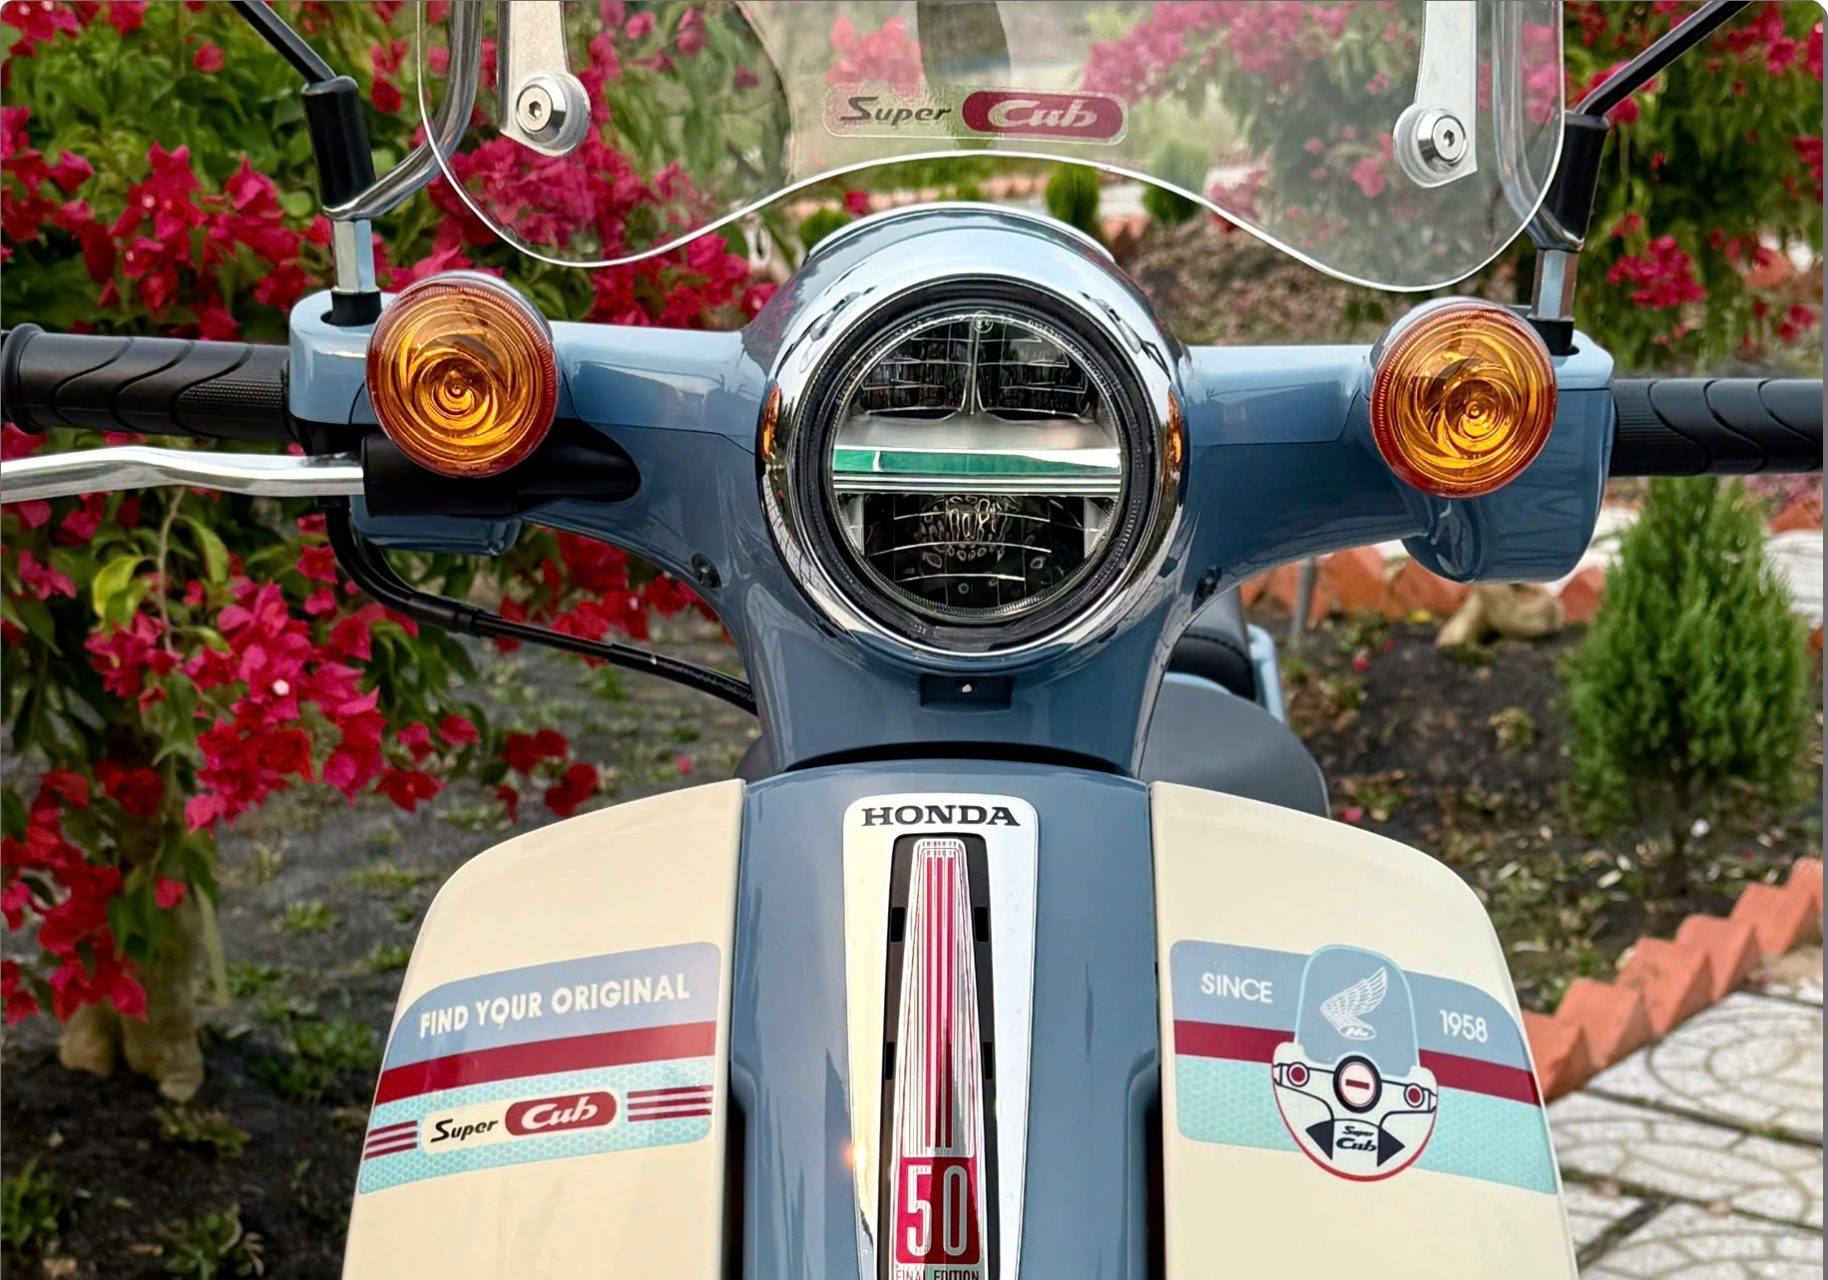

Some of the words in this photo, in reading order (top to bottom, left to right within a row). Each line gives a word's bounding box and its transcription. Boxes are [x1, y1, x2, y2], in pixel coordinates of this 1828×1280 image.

[840, 96, 952, 126] Super
[988, 99, 1098, 128] Cub
[861, 804, 1021, 827] HONDA
[1201, 972, 1274, 1004] SINCE
[420, 1008, 468, 1037] FIND
[477, 993, 543, 1028] YOUR
[551, 973, 690, 1013] ORIGINAL
[1438, 1009, 1489, 1043] 1958
[430, 1118, 499, 1143] Super
[521, 1096, 599, 1130] Cub
[1342, 1125, 1375, 1137] Super
[1336, 1137, 1377, 1151] Cub
[907, 1165, 968, 1256] 50
